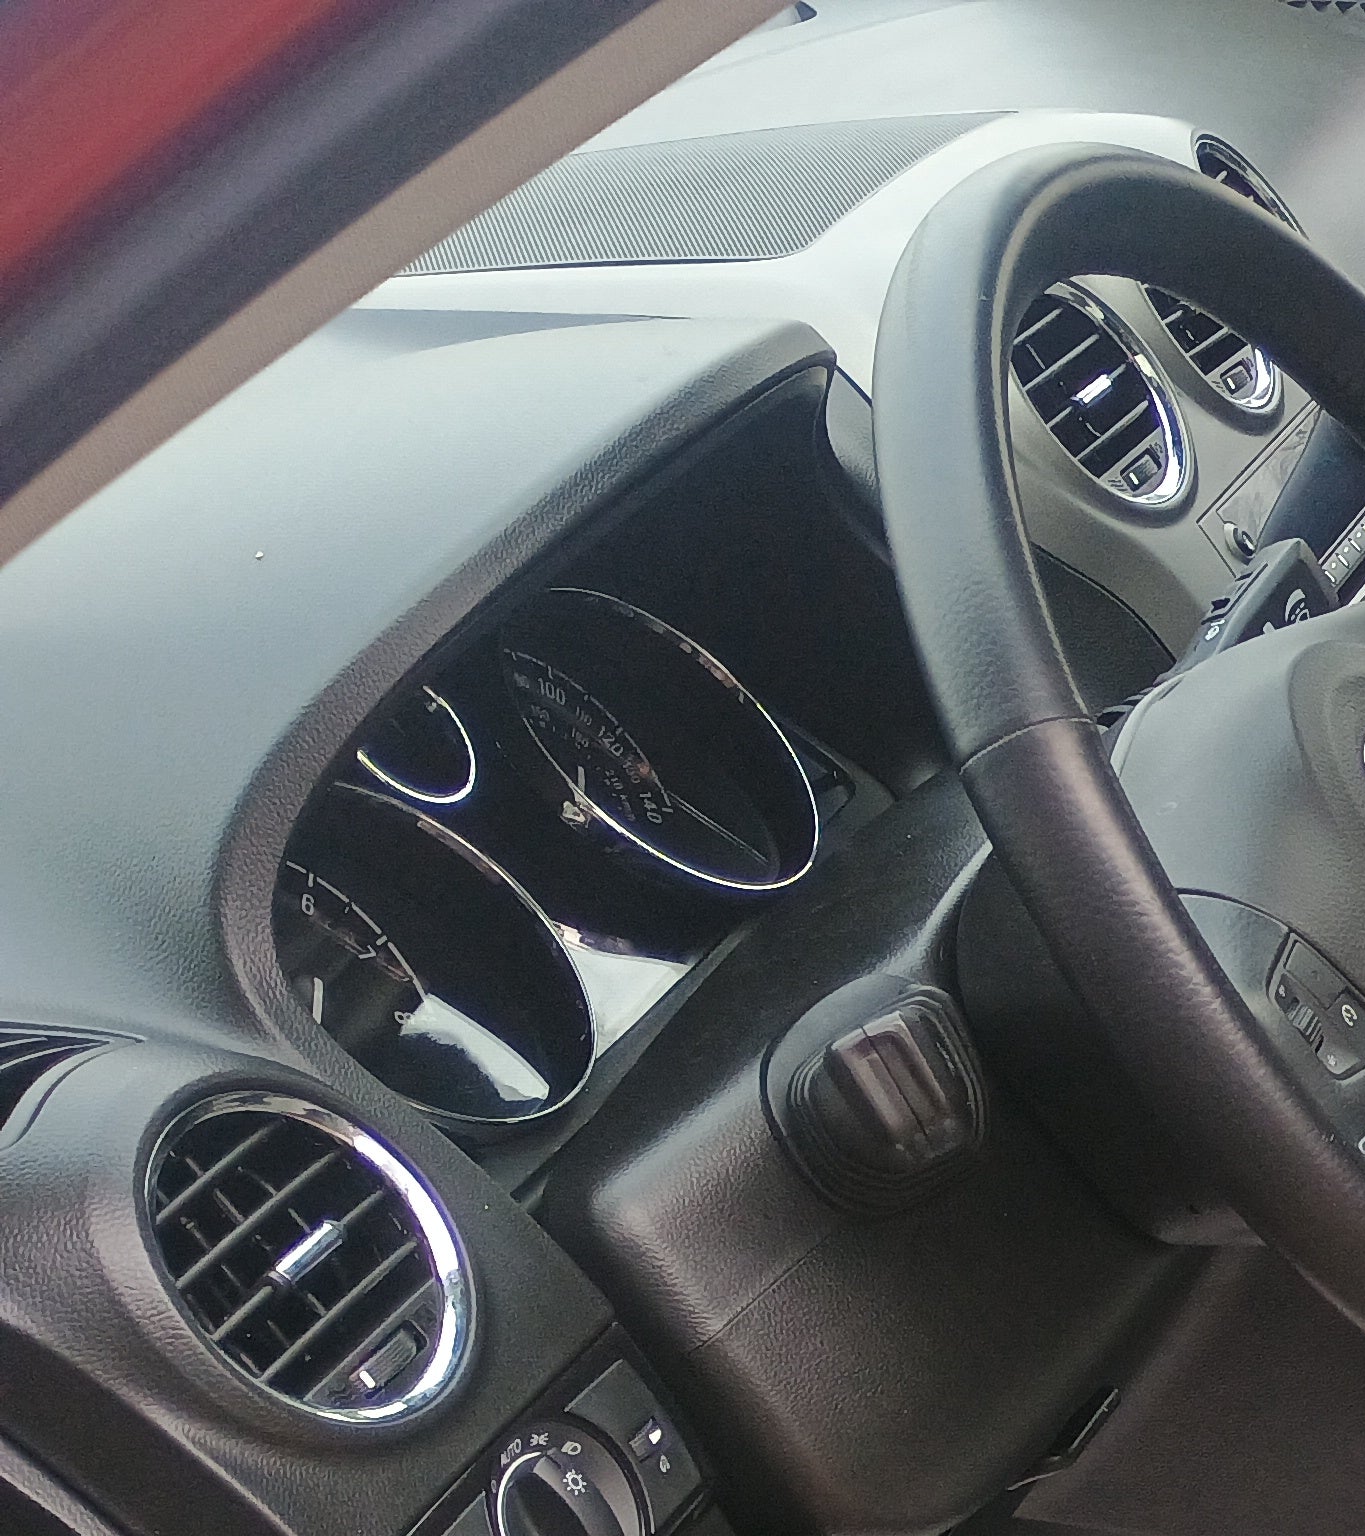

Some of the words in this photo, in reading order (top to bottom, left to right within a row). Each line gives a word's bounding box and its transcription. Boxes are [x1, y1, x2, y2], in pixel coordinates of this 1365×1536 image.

[537, 677, 566, 705] 100
[598, 725, 624, 757] 120
[639, 791, 663, 824] 140
[301, 893, 315, 916] 6
[358, 944, 377, 960] 7
